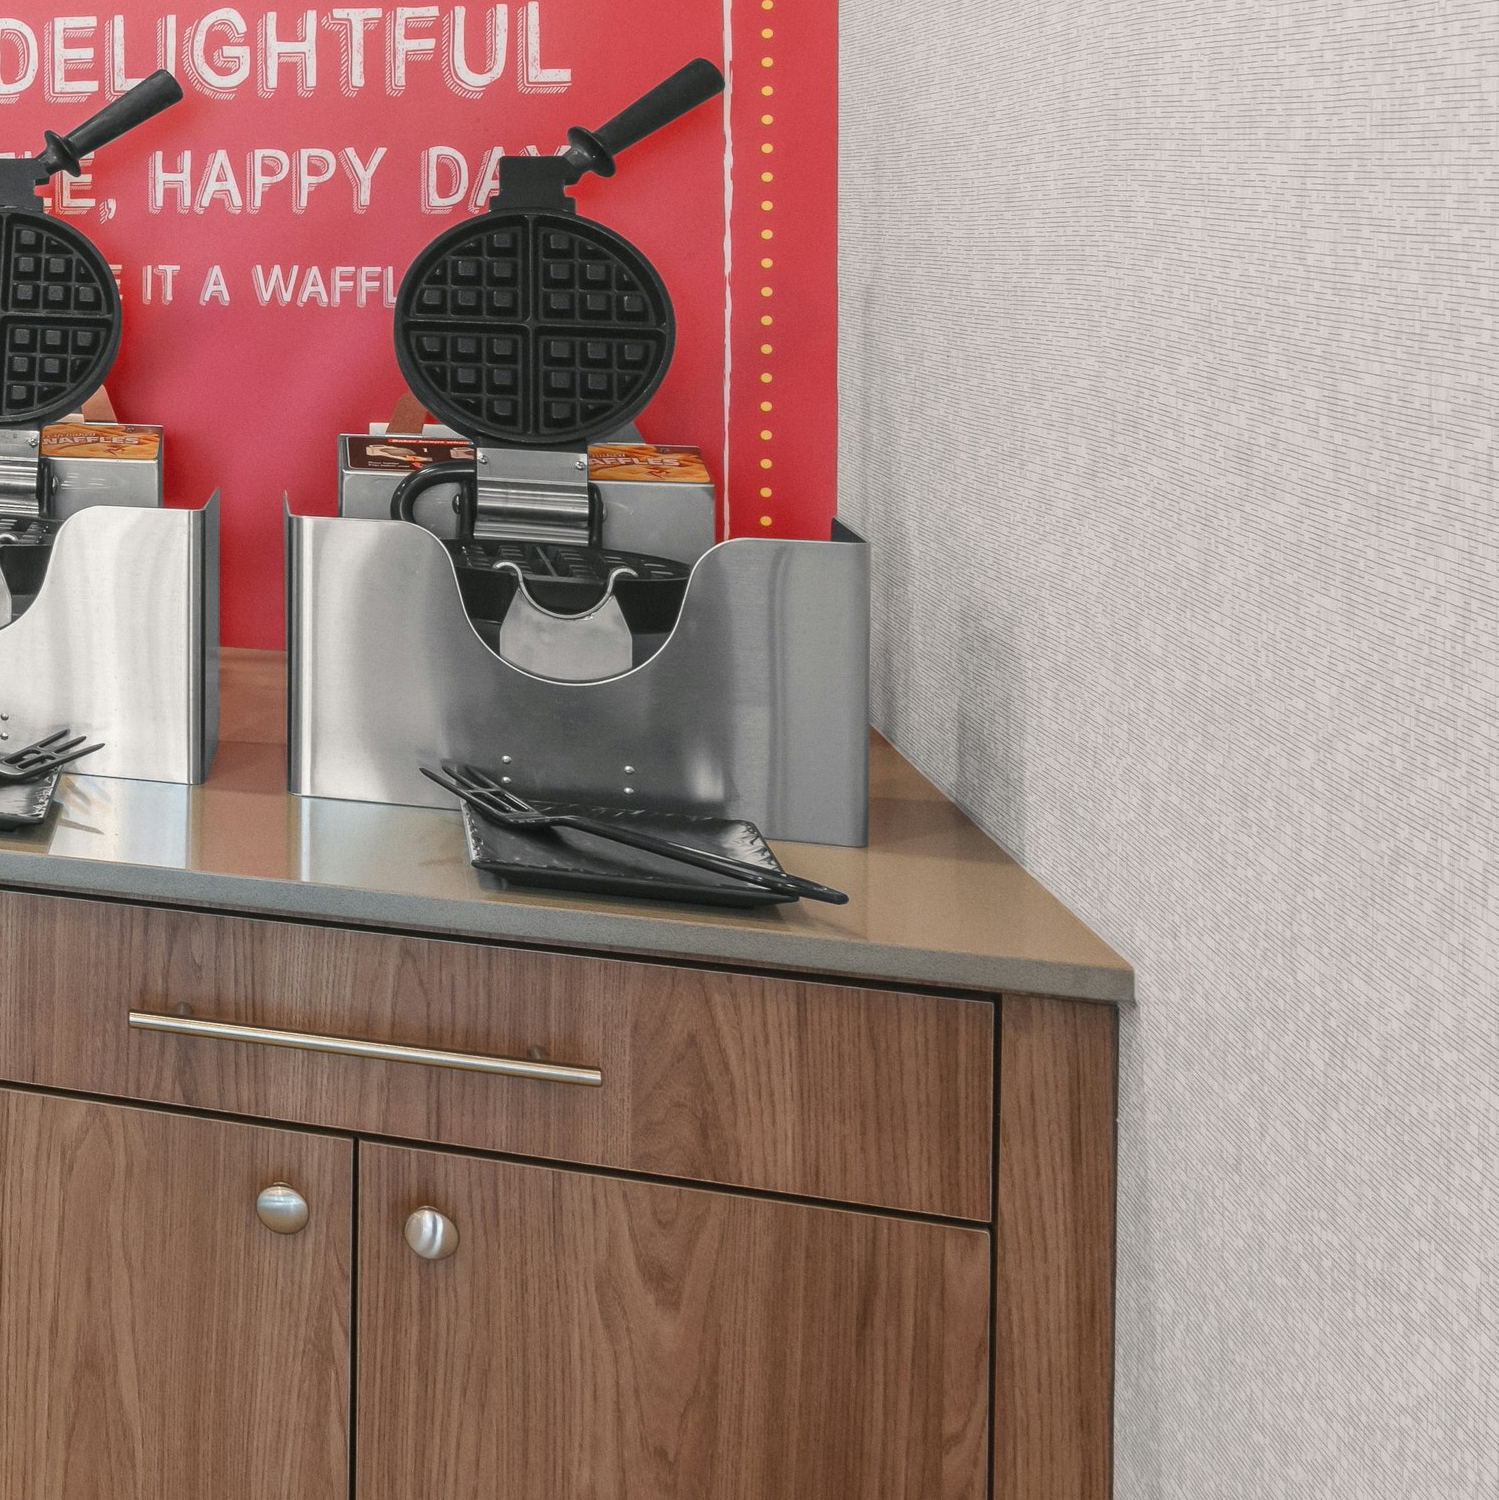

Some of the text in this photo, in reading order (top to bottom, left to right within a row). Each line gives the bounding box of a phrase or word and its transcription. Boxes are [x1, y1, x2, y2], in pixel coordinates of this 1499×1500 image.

[148, 146, 387, 215] HAPPY
[419, 145, 571, 215] DA
[142, 264, 180, 306] IT
[199, 264, 230, 306] A
